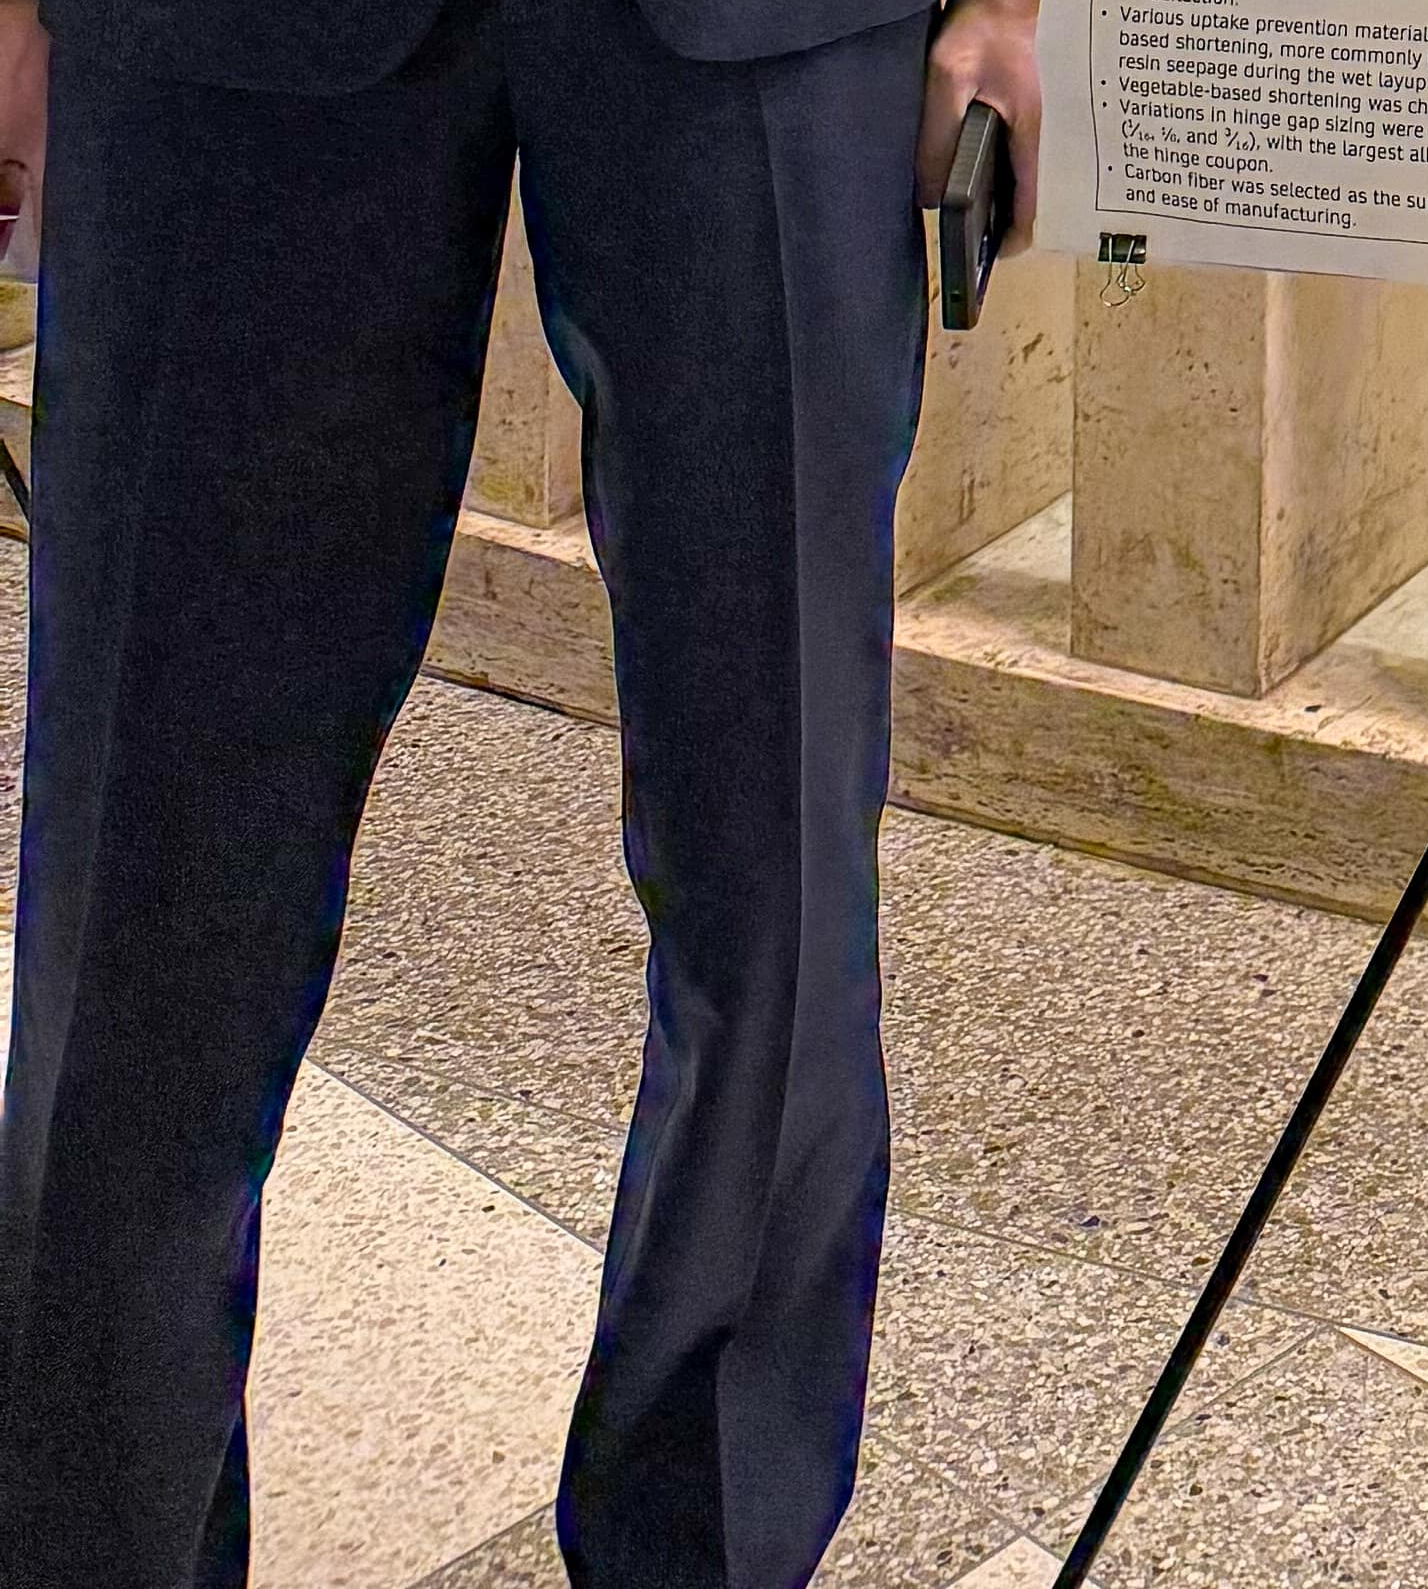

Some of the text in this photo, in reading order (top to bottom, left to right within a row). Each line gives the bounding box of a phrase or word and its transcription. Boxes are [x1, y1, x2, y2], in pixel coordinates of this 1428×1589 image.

[1126, 188, 1357, 230] and ease of manufacturing.
